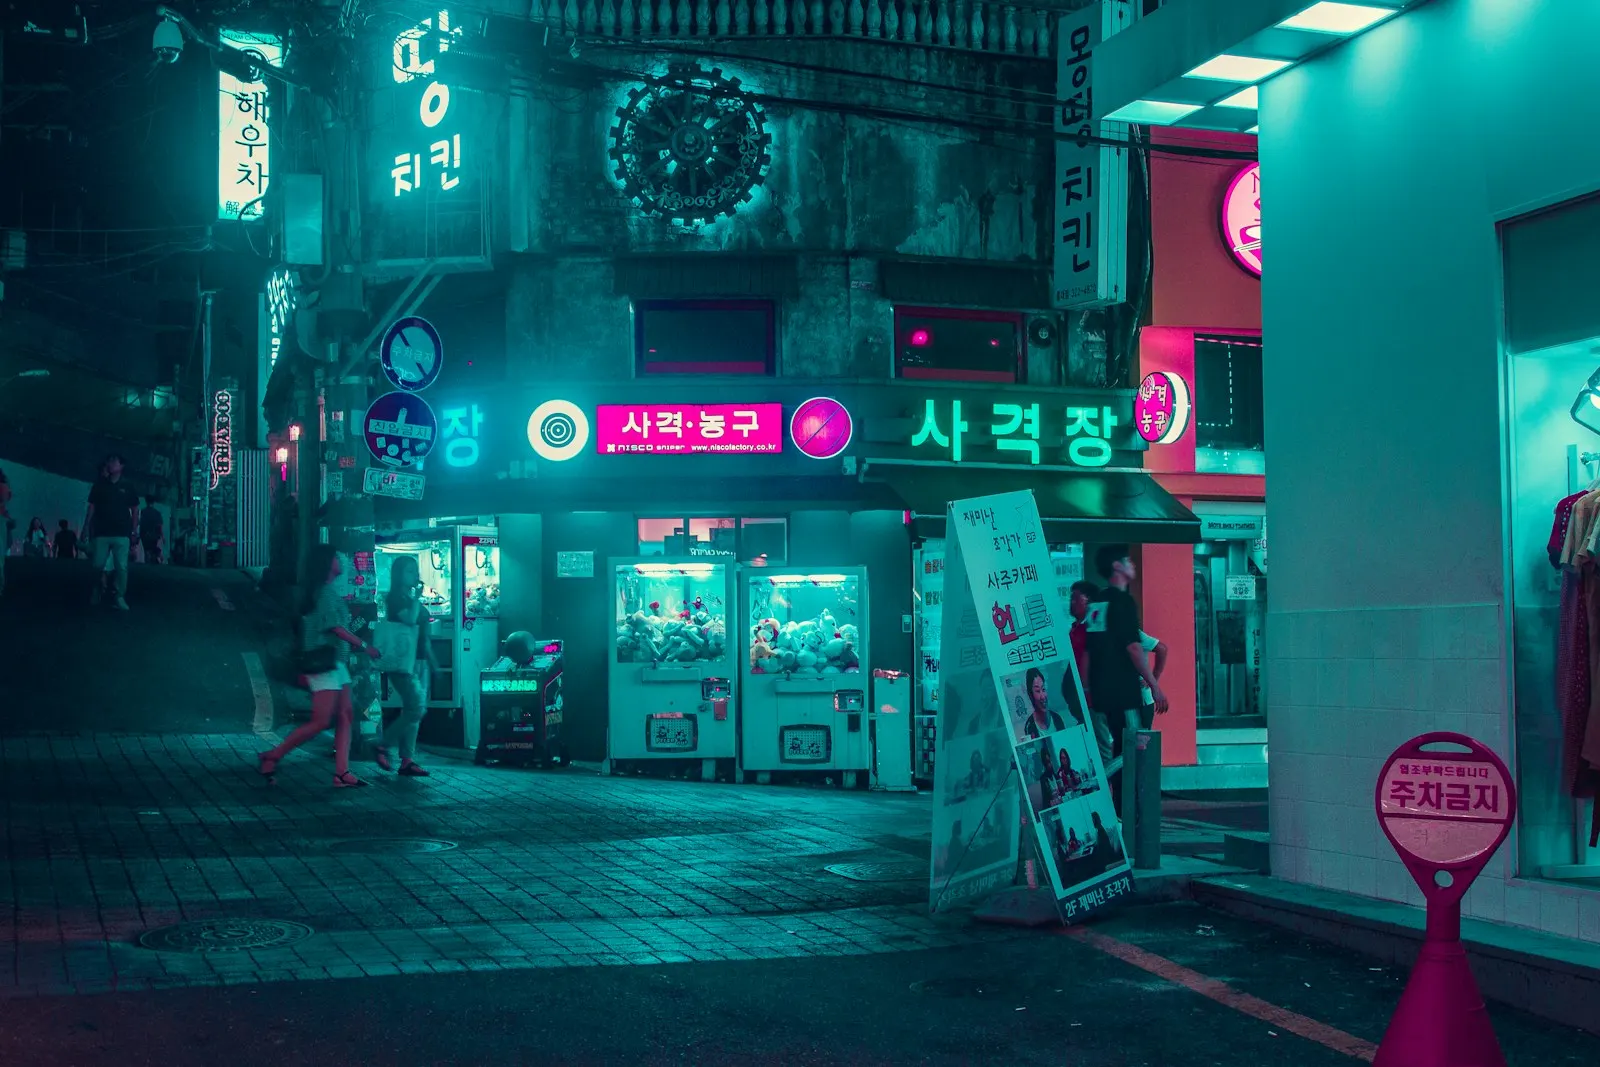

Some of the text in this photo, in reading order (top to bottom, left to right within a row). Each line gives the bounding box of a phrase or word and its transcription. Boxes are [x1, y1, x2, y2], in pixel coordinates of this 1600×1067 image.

[235, 91, 269, 195] 해우차
[391, 133, 461, 197] 치킨
[1061, 165, 1092, 274] 치킨
[391, 346, 434, 362] 주차금지
[373, 420, 429, 438] 진입금지
[441, 403, 484, 468] 장
[911, 399, 1118, 467] 사격장
[1140, 408, 1167, 434] 농구
[963, 507, 998, 531] 재미난
[992, 532, 1021, 557] 조각가
[987, 564, 1039, 590] 사주카페
[1006, 635, 1058, 666] 슬램덩크
[1390, 780, 1499, 813] 주차금지
[1065, 877, 1131, 917] 2F 재미난 조각가
